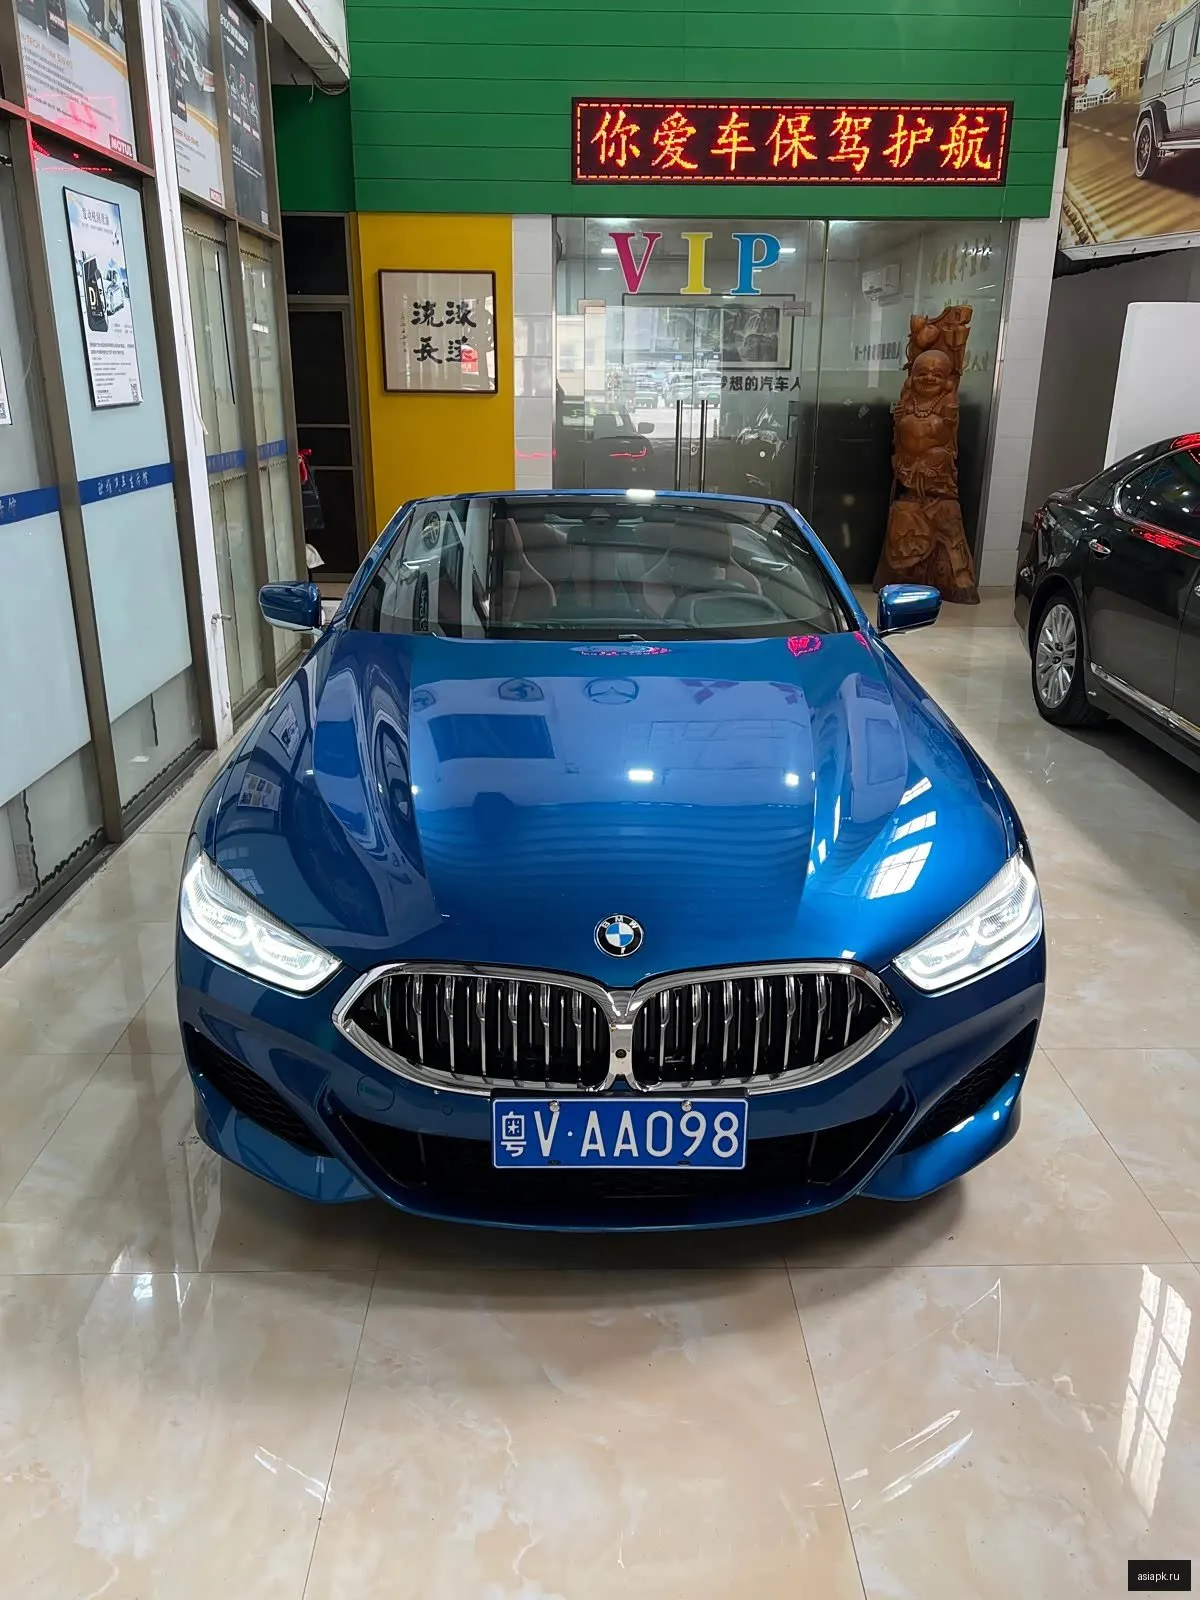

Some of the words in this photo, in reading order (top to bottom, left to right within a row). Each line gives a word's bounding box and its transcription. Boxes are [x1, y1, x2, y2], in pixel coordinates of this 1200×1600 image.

[110, 136, 132, 158] MOTUL
[590, 110, 992, 173] 你爱车保驾护航
[608, 231, 782, 296] VIP
[600, 915, 639, 929] BMW
